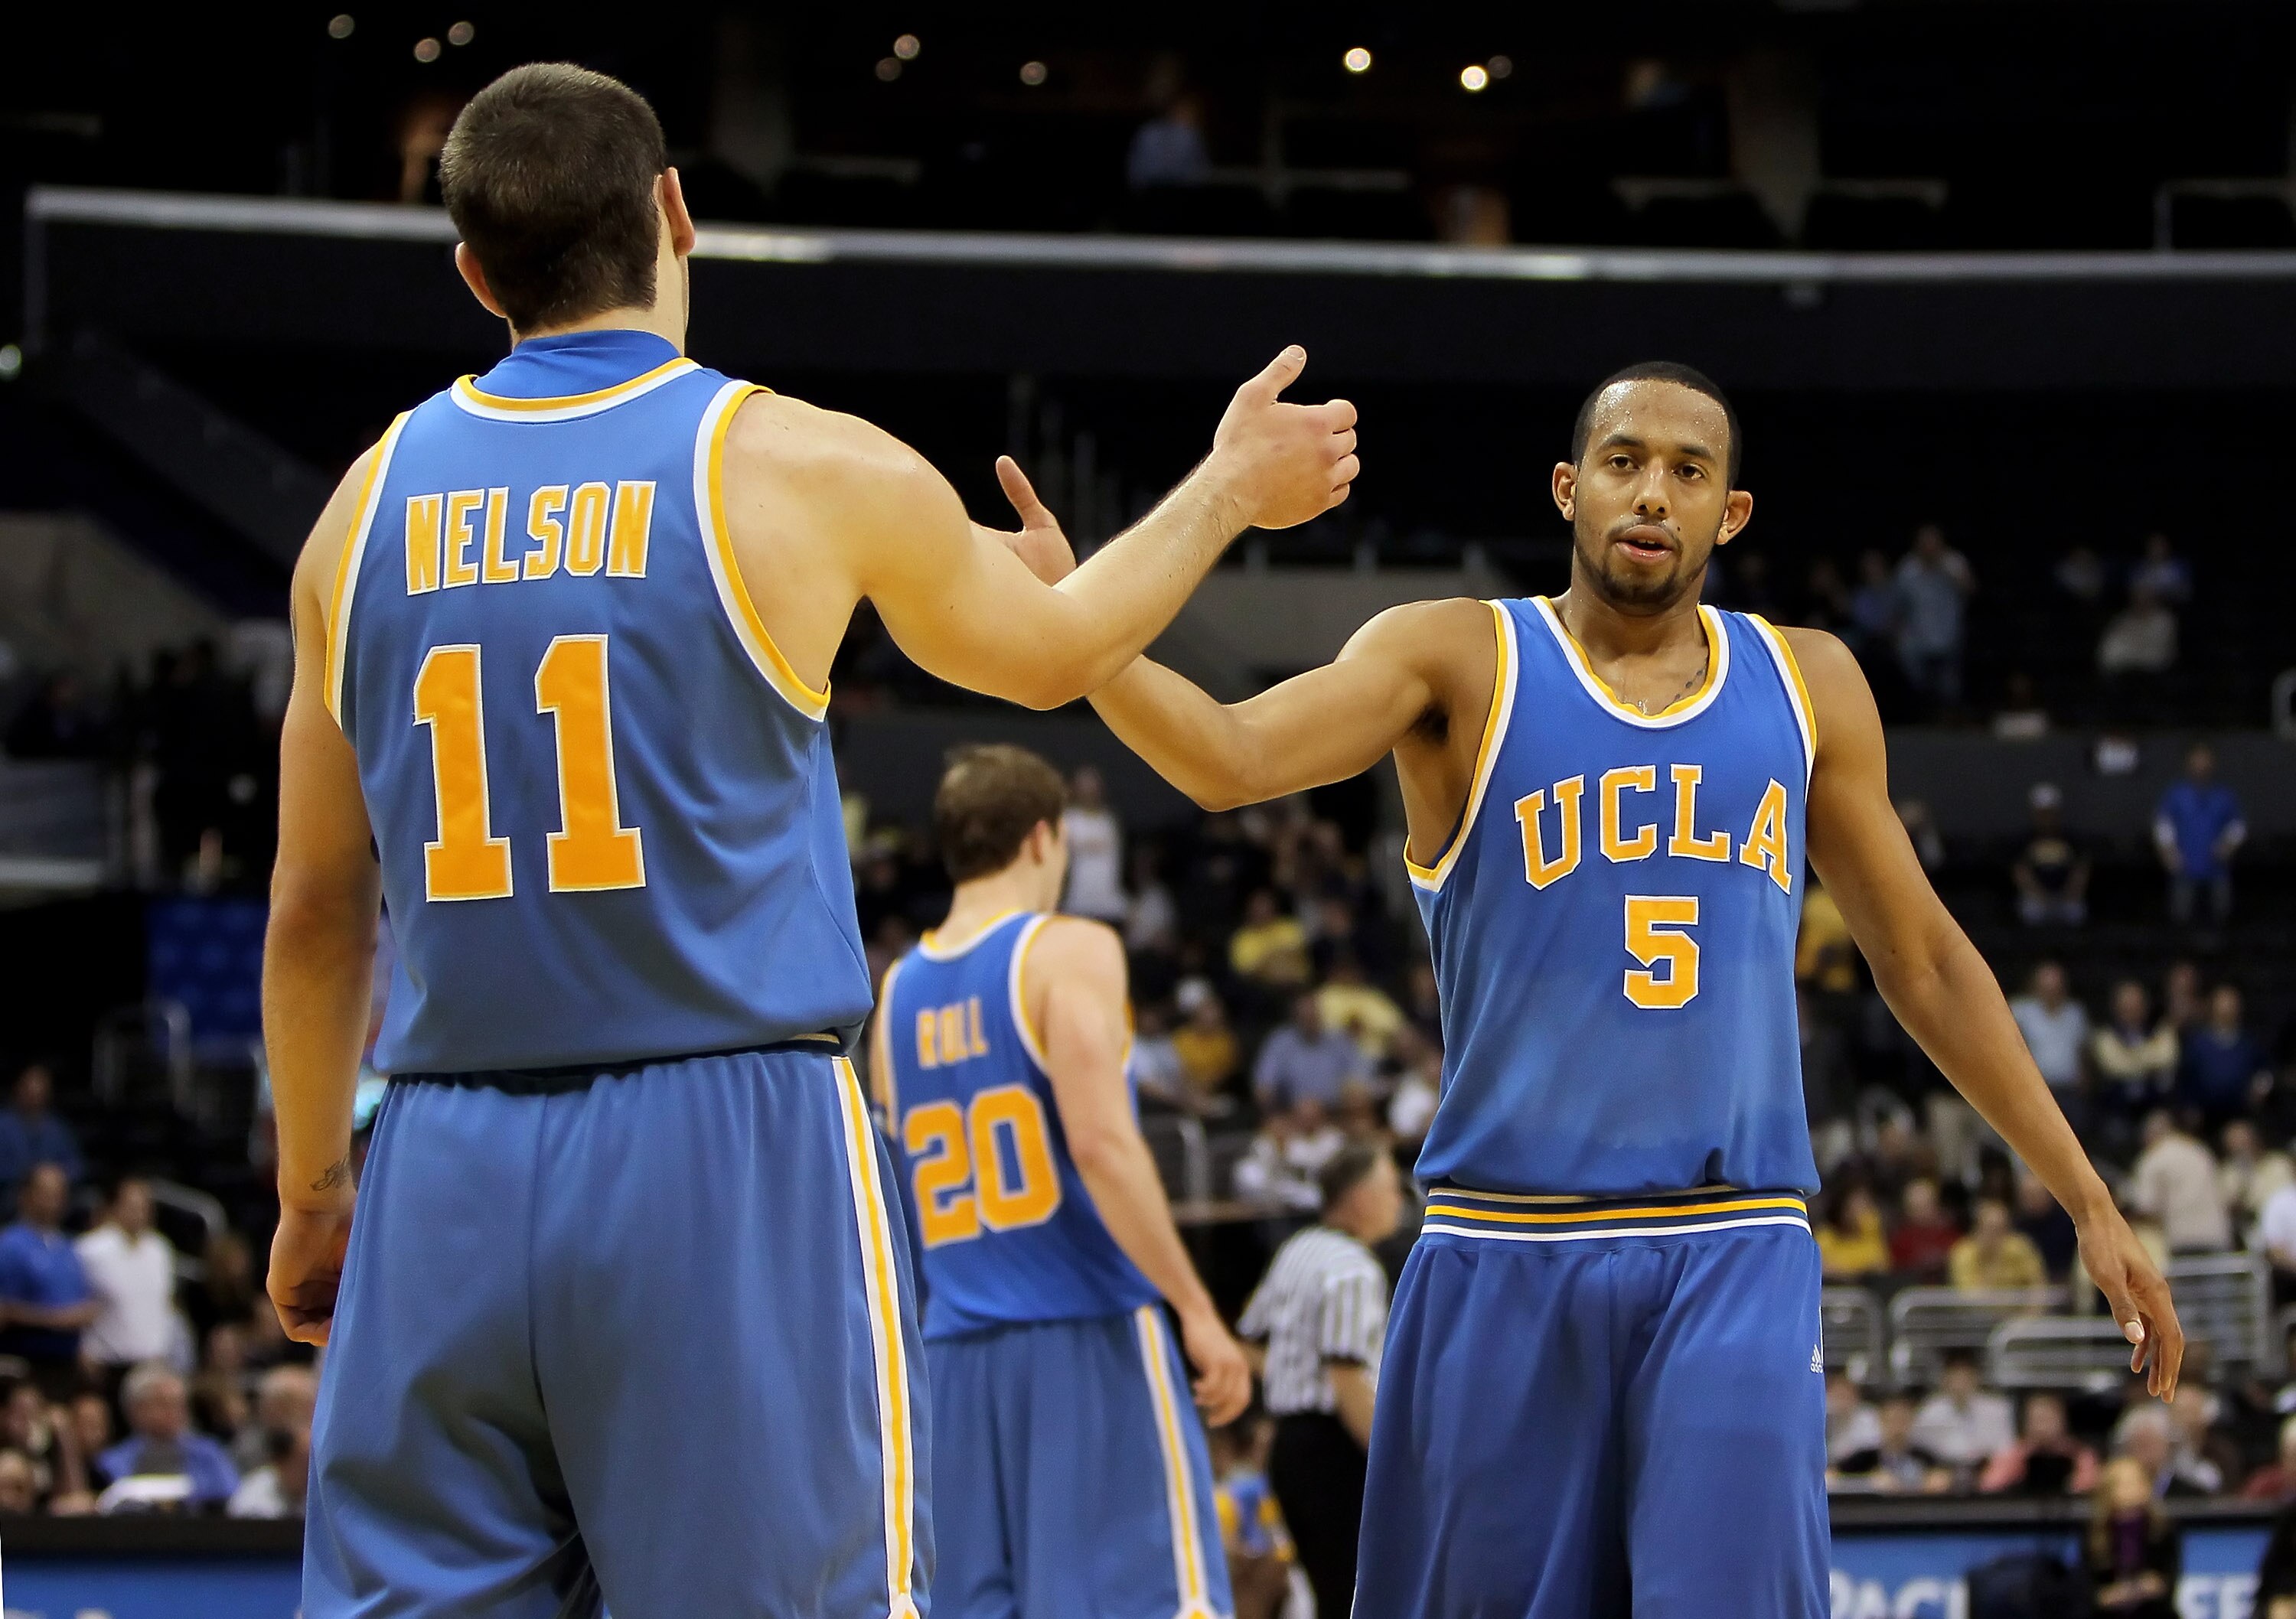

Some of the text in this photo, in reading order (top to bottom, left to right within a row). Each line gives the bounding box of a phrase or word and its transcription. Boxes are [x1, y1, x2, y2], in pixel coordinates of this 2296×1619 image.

[406, 480, 656, 595] NELSON
[413, 634, 646, 902] 11
[1514, 764, 1792, 894] UCLA
[1623, 894, 1699, 1008] 5
[904, 1081, 1062, 1249] 20
